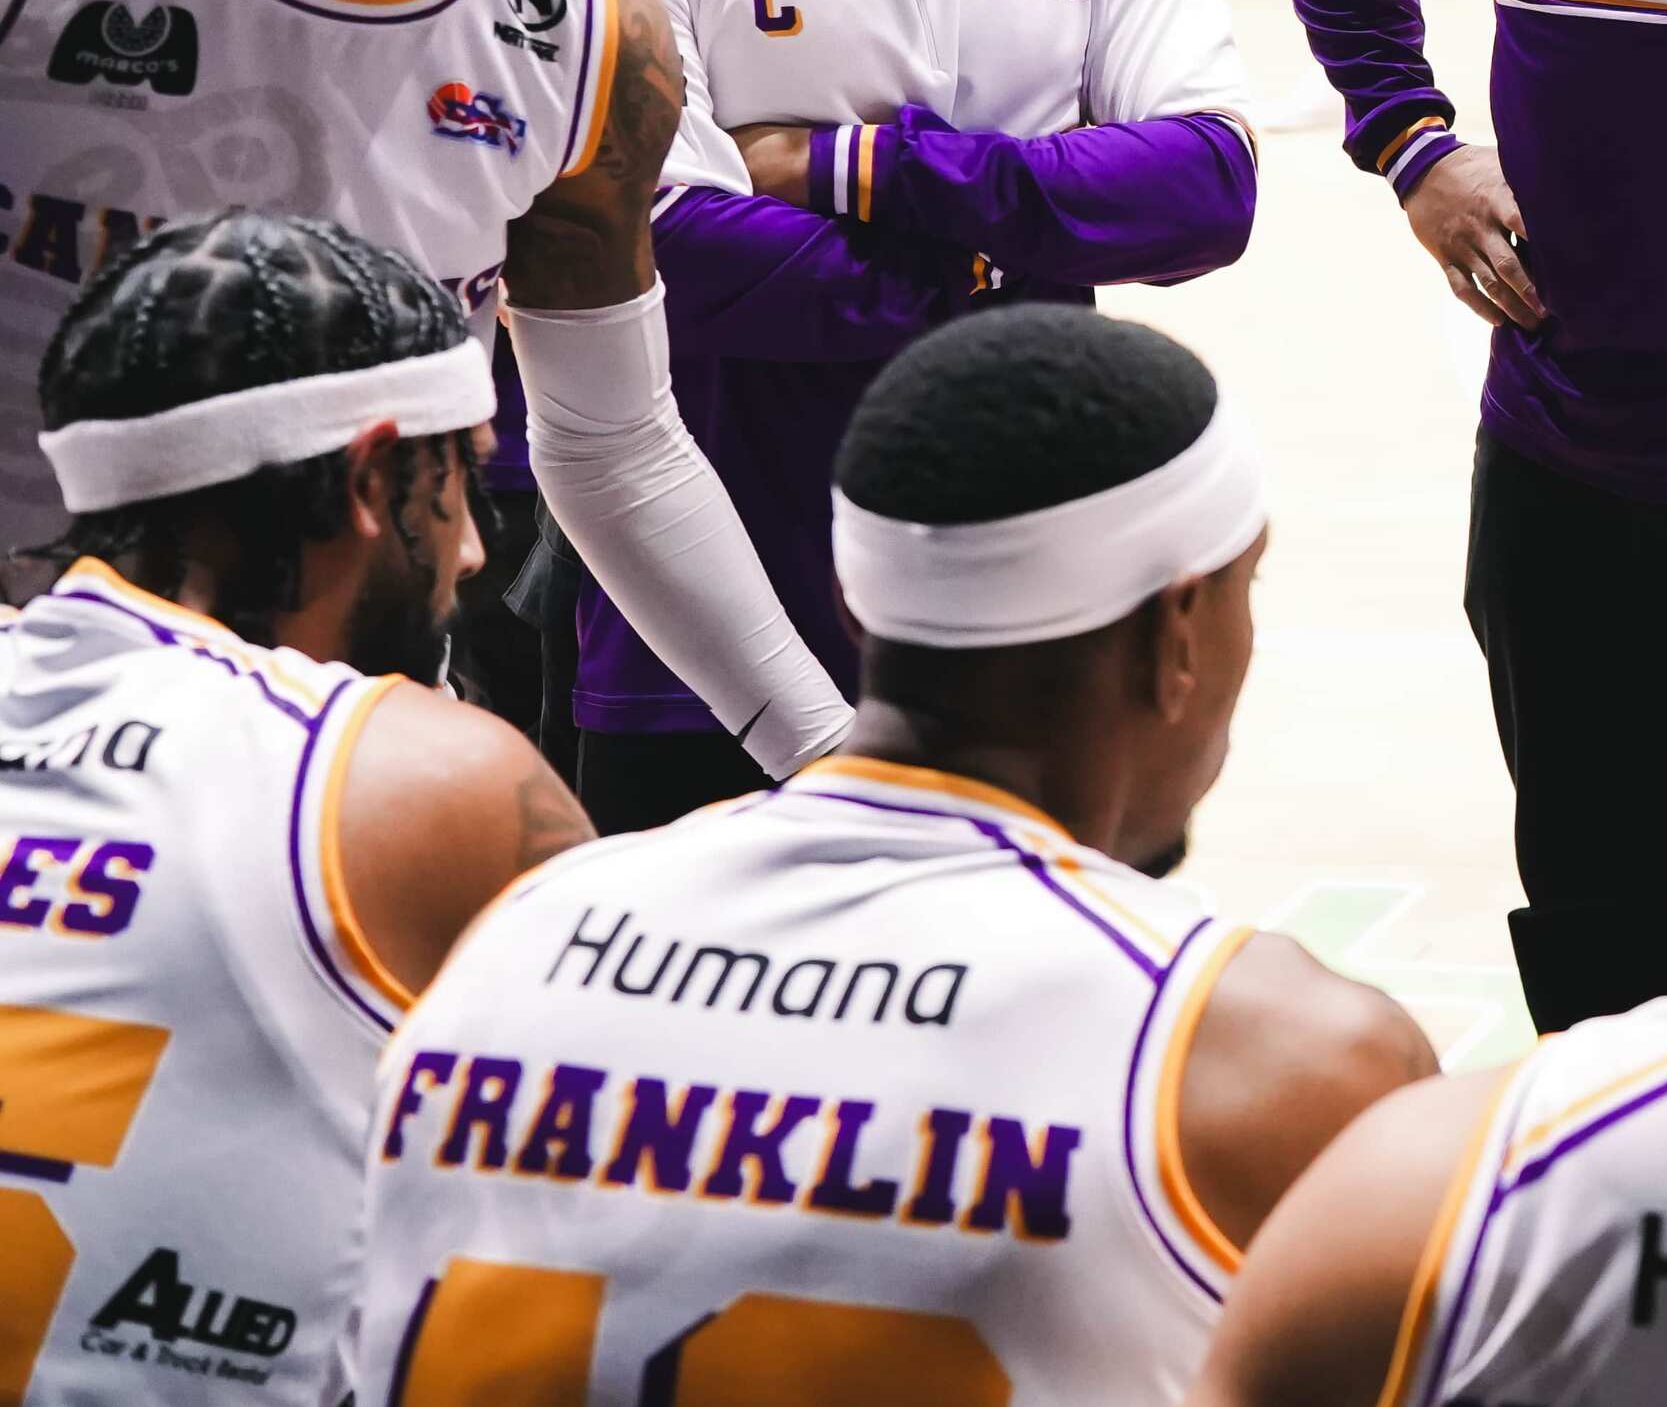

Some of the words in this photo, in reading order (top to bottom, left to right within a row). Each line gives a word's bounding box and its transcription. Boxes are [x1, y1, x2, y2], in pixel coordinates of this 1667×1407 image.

[545, 906, 970, 1027] Humana
[380, 1049, 1083, 1243] FRANKLIN
[89, 1246, 298, 1358] ALLIED
